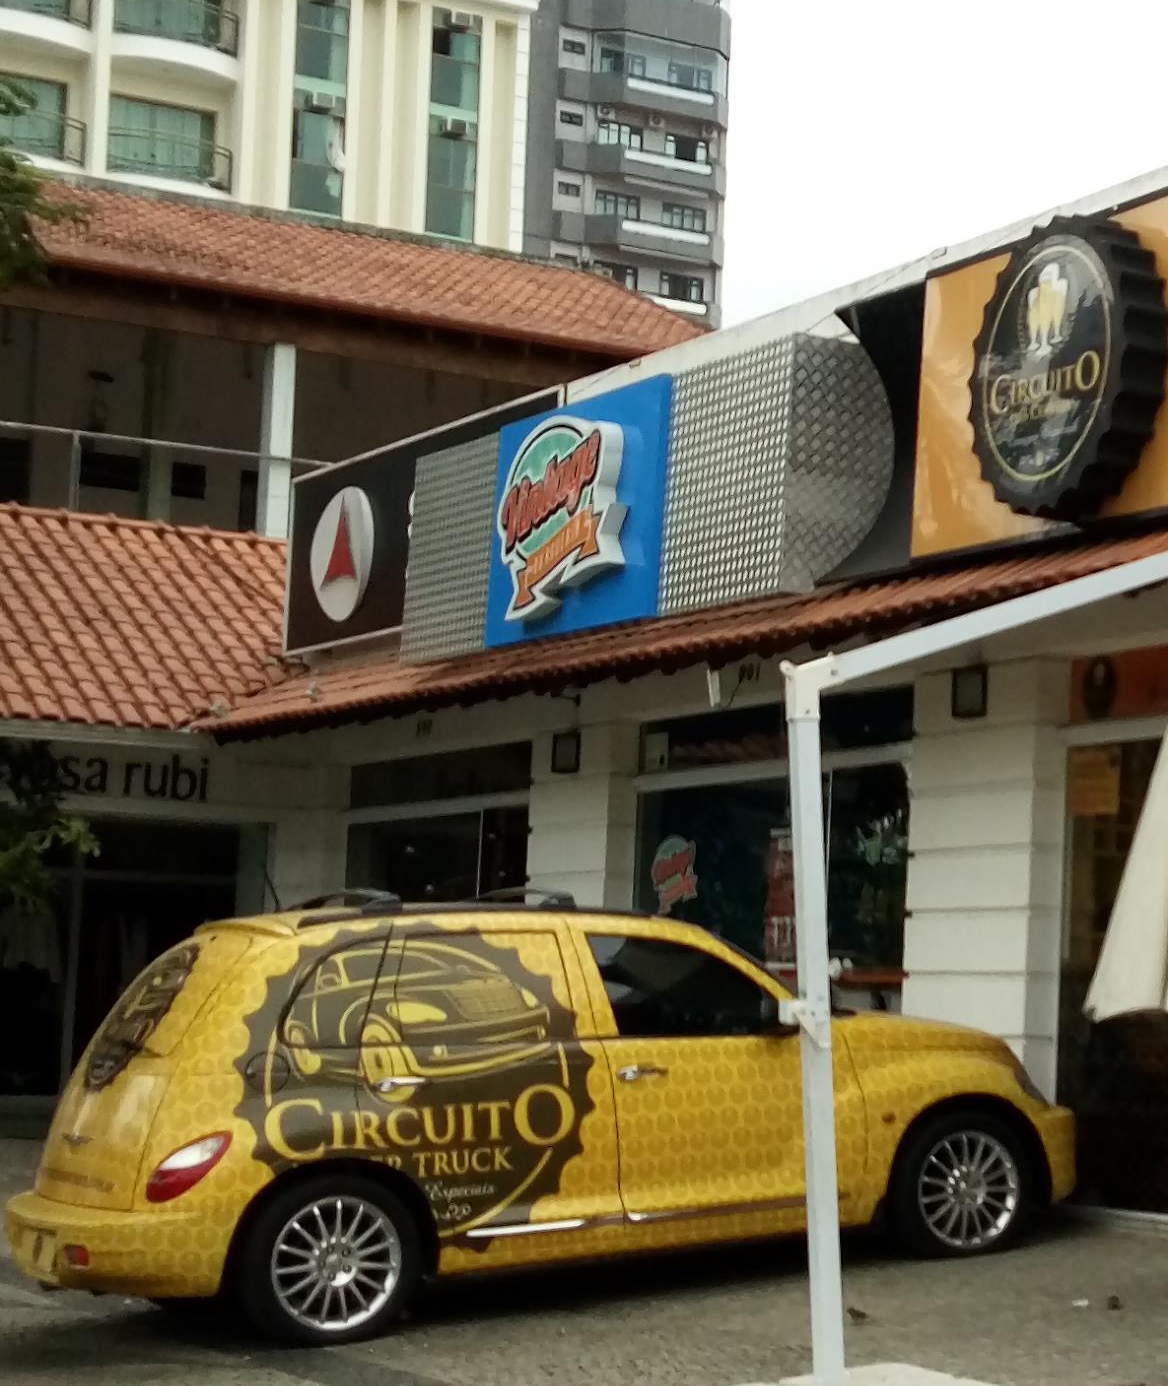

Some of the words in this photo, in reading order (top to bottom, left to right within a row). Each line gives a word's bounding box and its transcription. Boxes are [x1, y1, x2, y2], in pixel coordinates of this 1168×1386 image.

[122, 754, 209, 801] rubi
[264, 1084, 575, 1160] CIRCUITO
[412, 1146, 514, 1178] TRUCK
